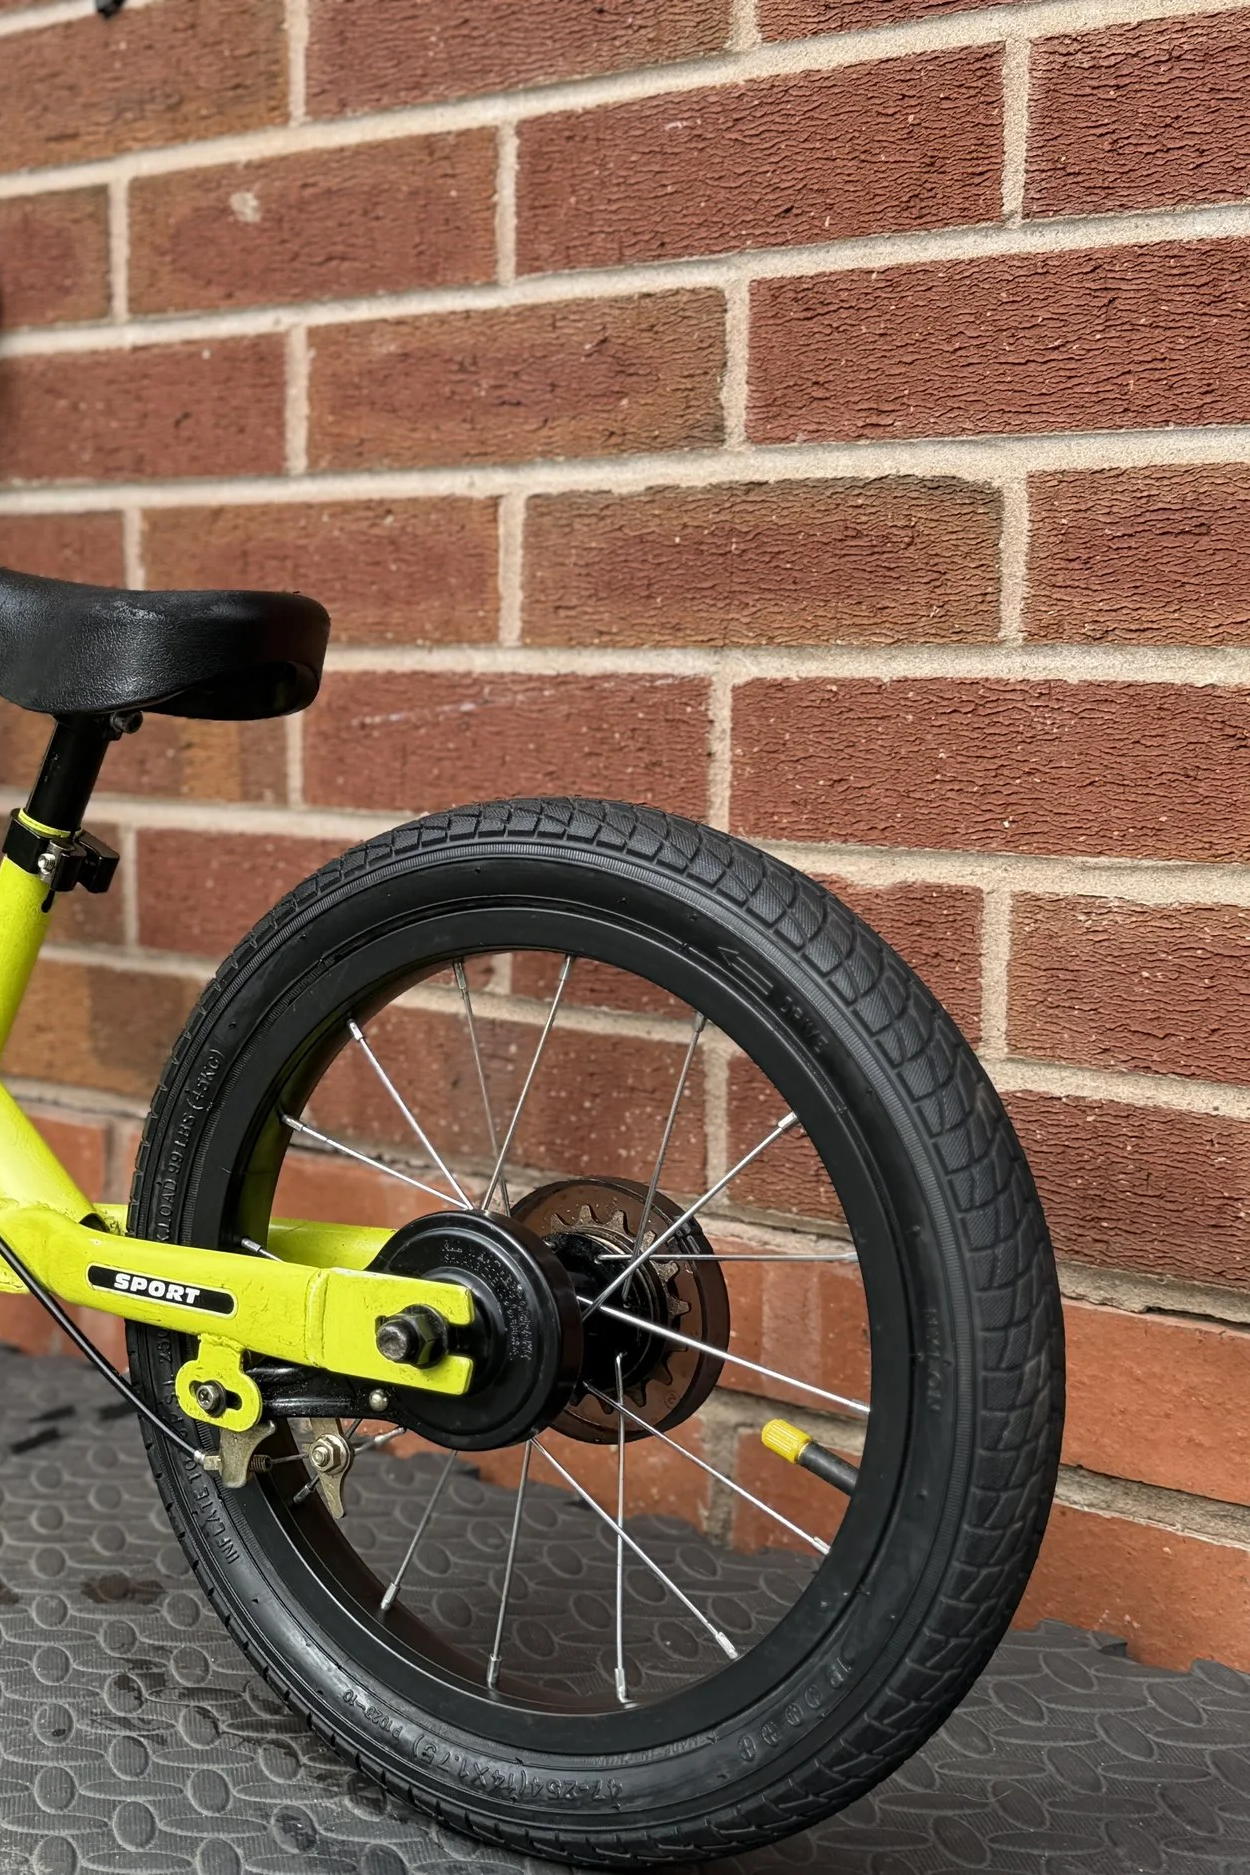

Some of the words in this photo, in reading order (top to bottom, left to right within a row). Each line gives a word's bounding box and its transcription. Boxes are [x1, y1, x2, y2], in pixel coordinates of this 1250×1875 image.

[174, 1112, 196, 1150] LBS
[114, 1272, 200, 1305] SPORT
[193, 1486, 240, 1565] INFLATE
